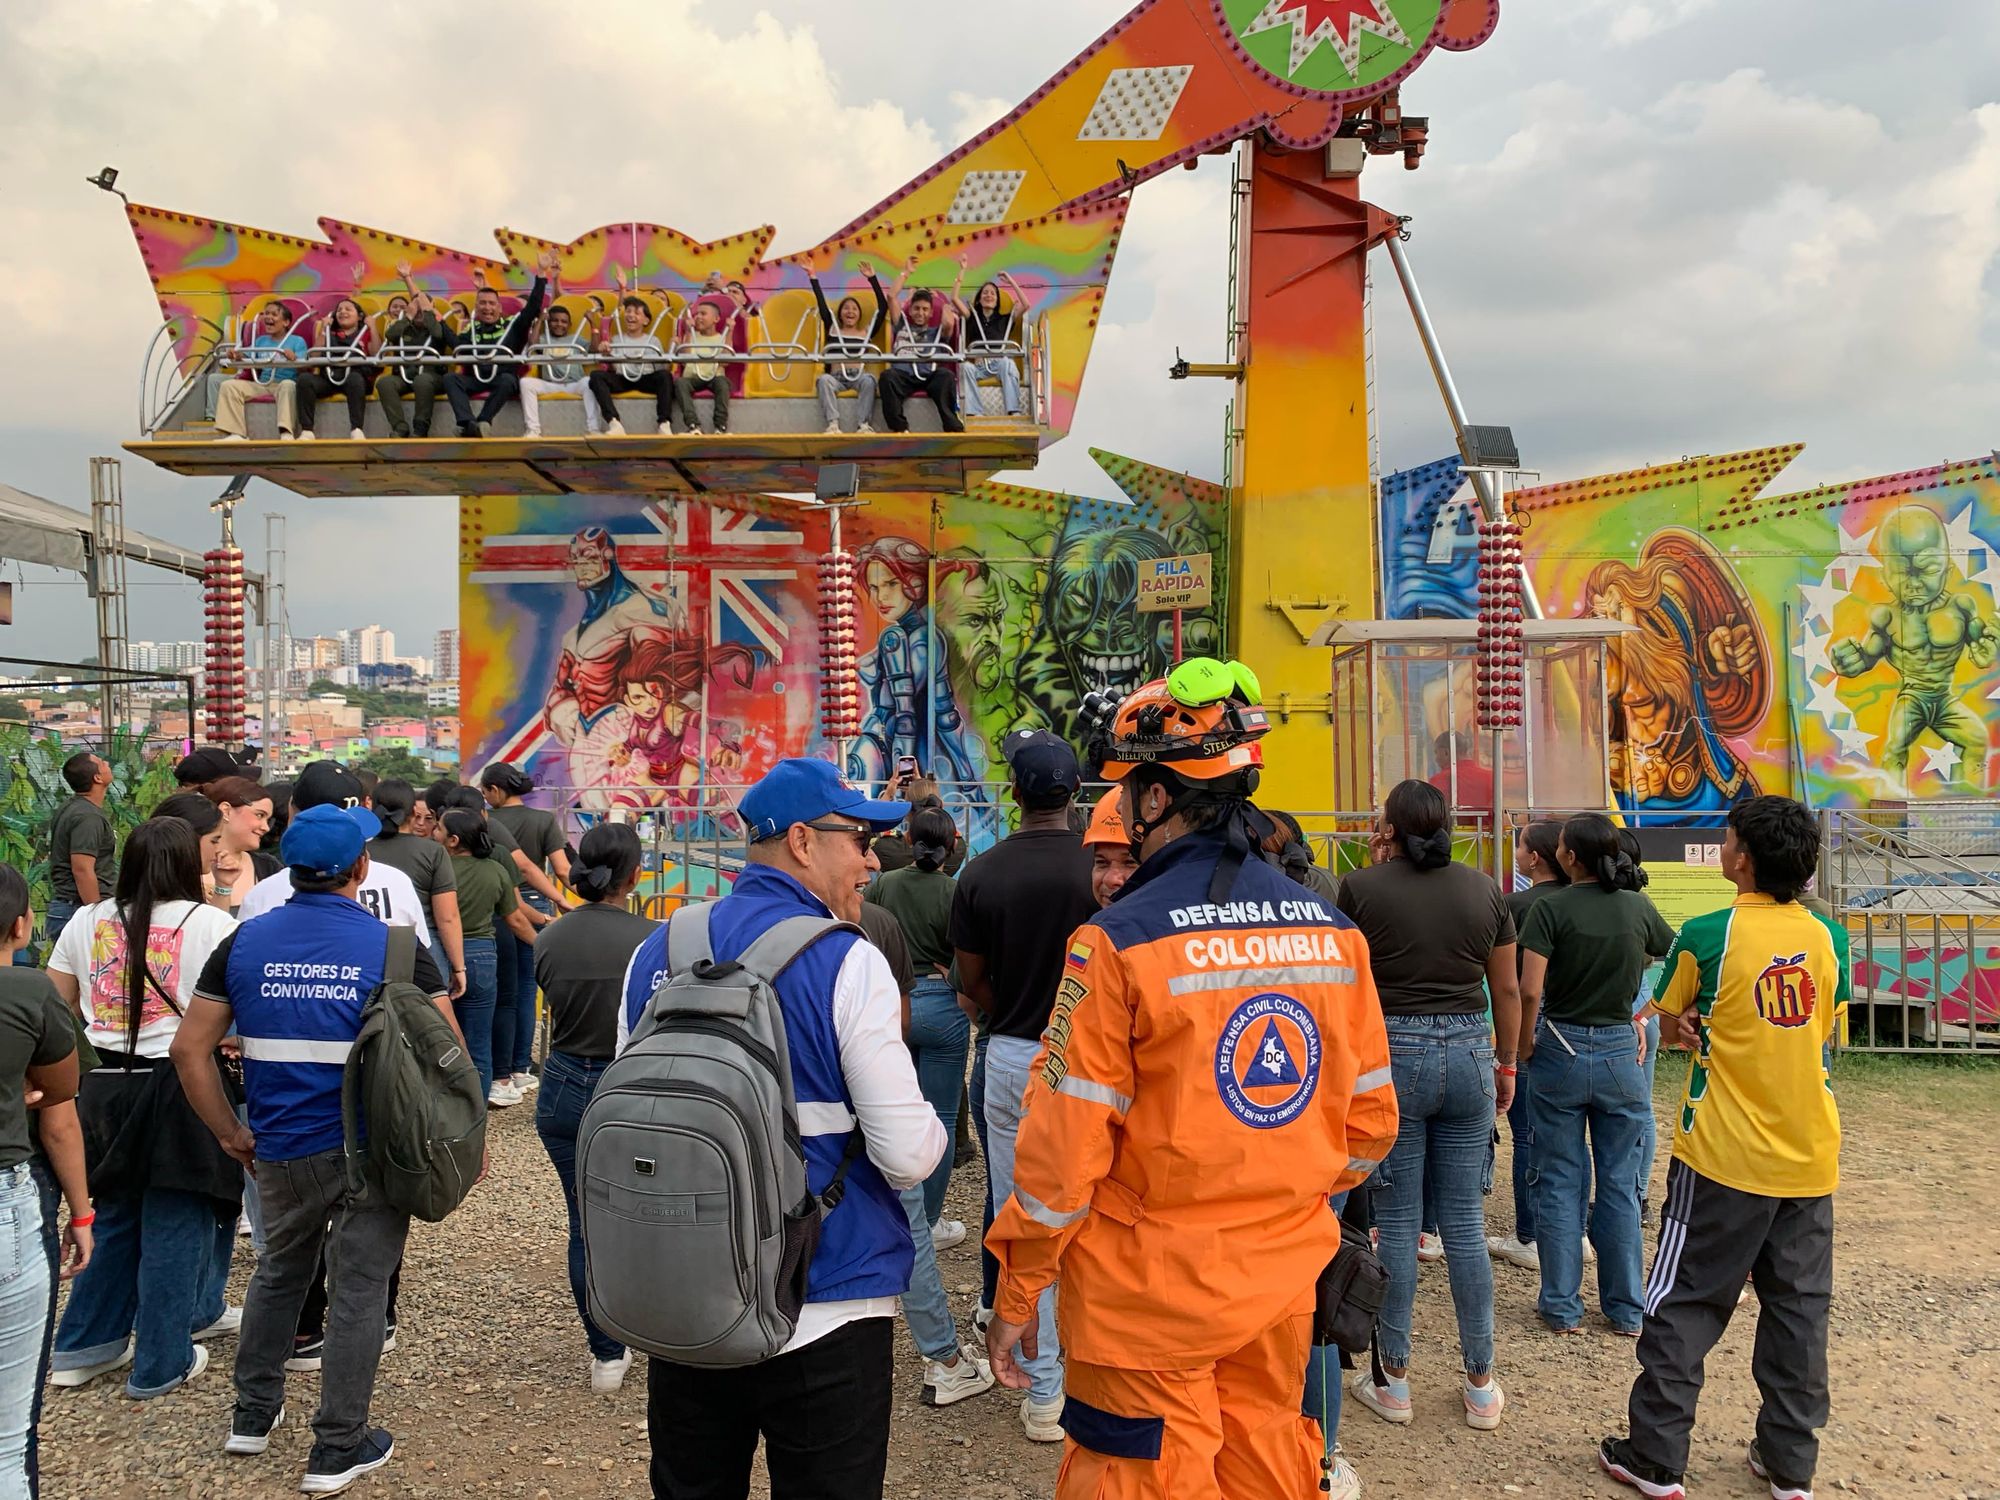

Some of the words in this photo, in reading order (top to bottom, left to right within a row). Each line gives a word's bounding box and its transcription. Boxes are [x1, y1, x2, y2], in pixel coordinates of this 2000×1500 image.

[1155, 559, 1191, 576] FILA
[1141, 574, 1205, 593] RAPIDA
[1155, 595, 1175, 605] Solo
[1176, 593, 1191, 603] VIP
[1116, 751, 1157, 762] STEELPRO
[1169, 901, 1278, 928] DEFENSA
[1279, 900, 1333, 922] CIVIL
[1184, 933, 1342, 968] COLOMBIA
[263, 962, 338, 979] GESTORES
[340, 966, 362, 981] DE
[260, 982, 358, 1001] CONVIVENCIA
[1220, 1013, 1249, 1074] DEFENSA
[1246, 999, 1274, 1017] CIVIL
[1274, 999, 1318, 1067] COLOMBIANA
[1265, 1051, 1282, 1064] DC
[1226, 1083, 1245, 1113] LISTOS
[1243, 1109, 1255, 1120] EN
[1254, 1112, 1268, 1122] PAZ
[1269, 1113, 1277, 1122] O
[1277, 1075, 1315, 1120] EMERGENCIA
